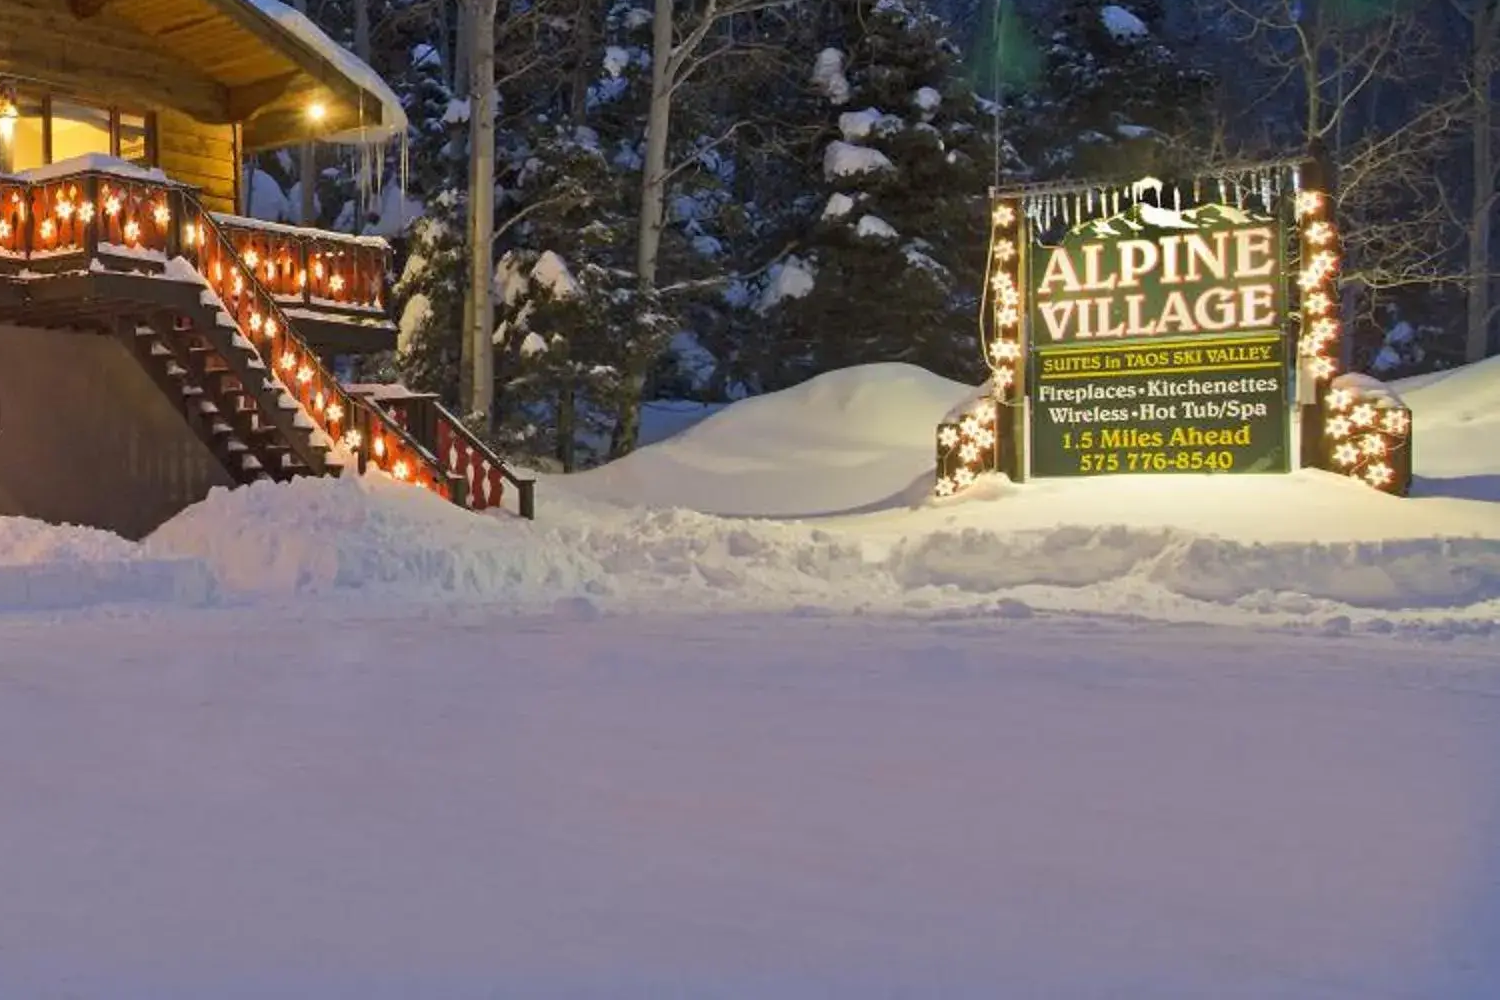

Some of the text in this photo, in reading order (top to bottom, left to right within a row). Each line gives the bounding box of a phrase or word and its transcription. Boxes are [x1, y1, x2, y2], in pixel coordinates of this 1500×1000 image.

[1037, 227, 1277, 294] ALPINE
[1038, 284, 1278, 341] VILLAGE
[1043, 346, 1272, 373] SUITES in TAOS SKI VALLEY
[1139, 403, 1176, 421] Hot
[1181, 400, 1268, 420] Tub/Spa
[1063, 425, 1251, 449] 1.5 Miles Ahead
[1080, 451, 1234, 472] 575 776-8540
